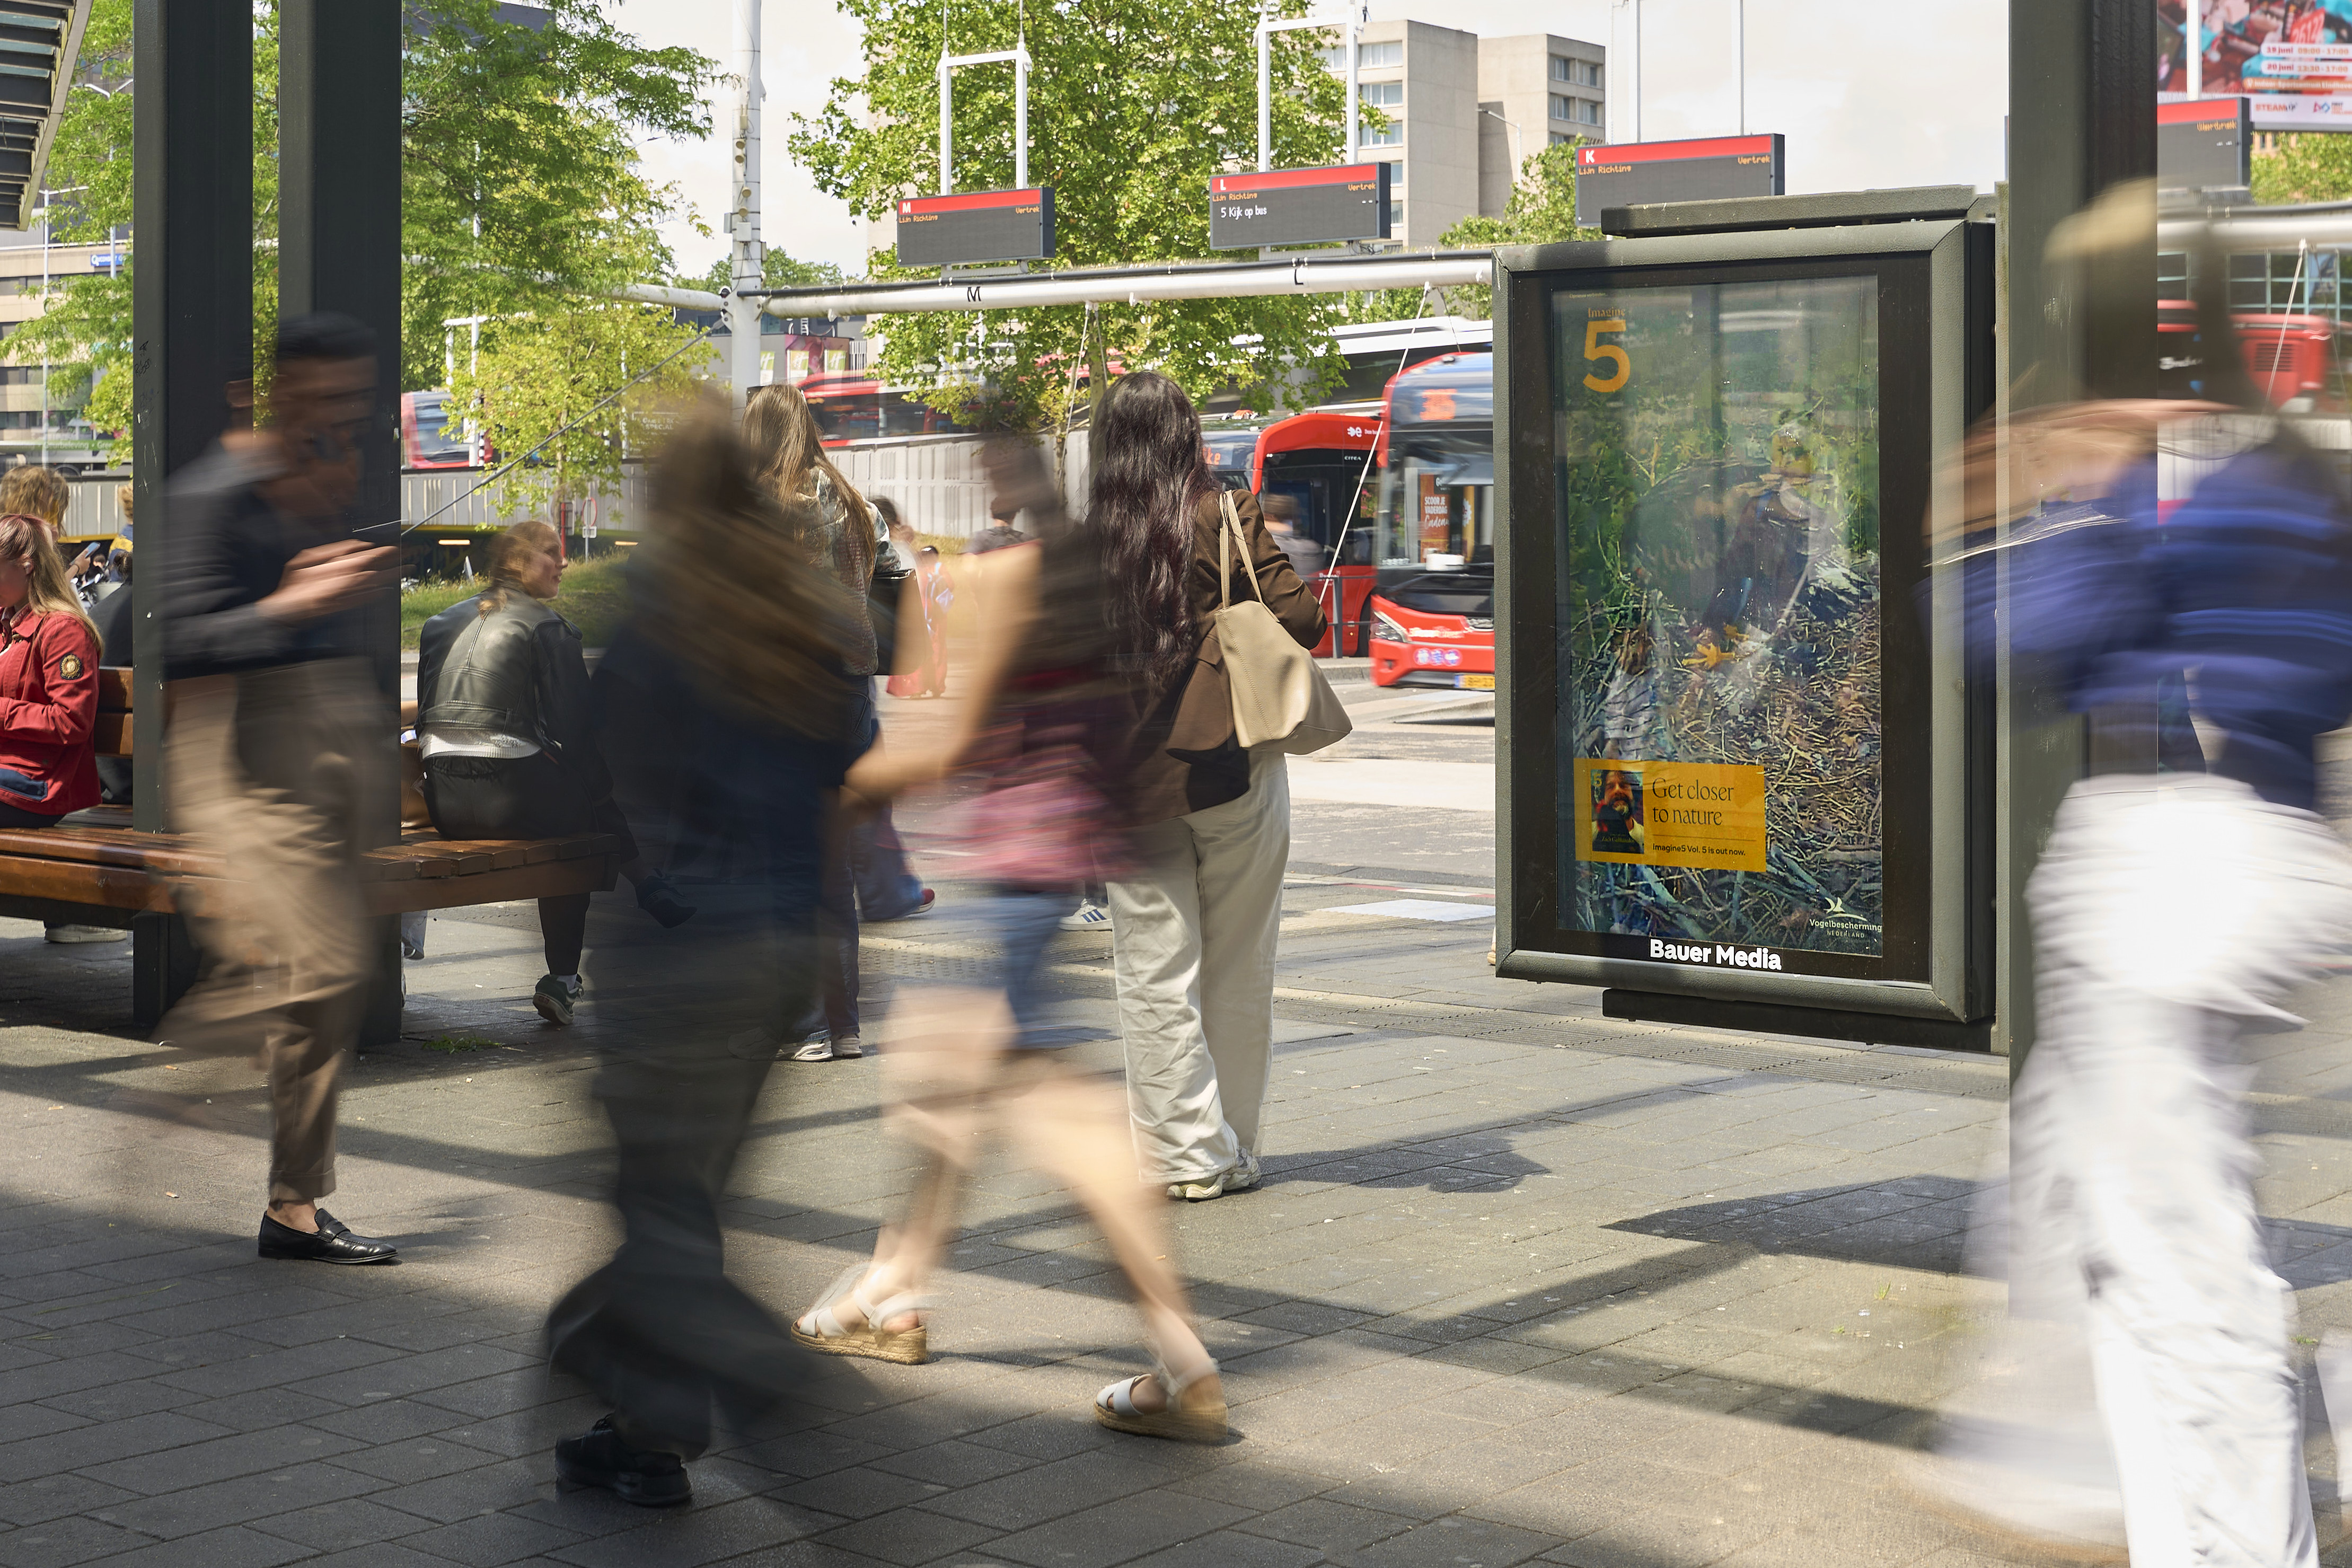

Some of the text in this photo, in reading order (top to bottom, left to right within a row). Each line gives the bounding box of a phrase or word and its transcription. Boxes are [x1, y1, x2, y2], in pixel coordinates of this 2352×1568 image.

[1585, 150, 1595, 163] K
[1738, 155, 1770, 165] Vertrek
[1598, 164, 1632, 174] Richting
[1220, 179, 1226, 191] L
[1348, 182, 1376, 191] Vertrek
[902, 202, 911, 214] M
[1016, 206, 1040, 215] Vertrek
[1221, 207, 1227, 218] 5
[1229, 206, 1243, 220] Kijk
[1244, 208, 1253, 219] op
[1255, 205, 1267, 215] bus
[1294, 269, 1303, 285] L
[967, 286, 981, 302] M
[1588, 307, 1625, 318] Imagine
[1583, 320, 1630, 392] 5
[1424, 496, 1440, 505] SCOOR
[1424, 505, 1448, 515] VADERDAG
[1652, 777, 1734, 801] Get closer
[1652, 807, 1722, 826] to nature
[1653, 843, 1686, 853] Imagine5
[1687, 845, 1700, 853] Vol.
[1809, 918, 1882, 933] Vogelbescherming
[1650, 938, 1782, 971] Bauer Media
